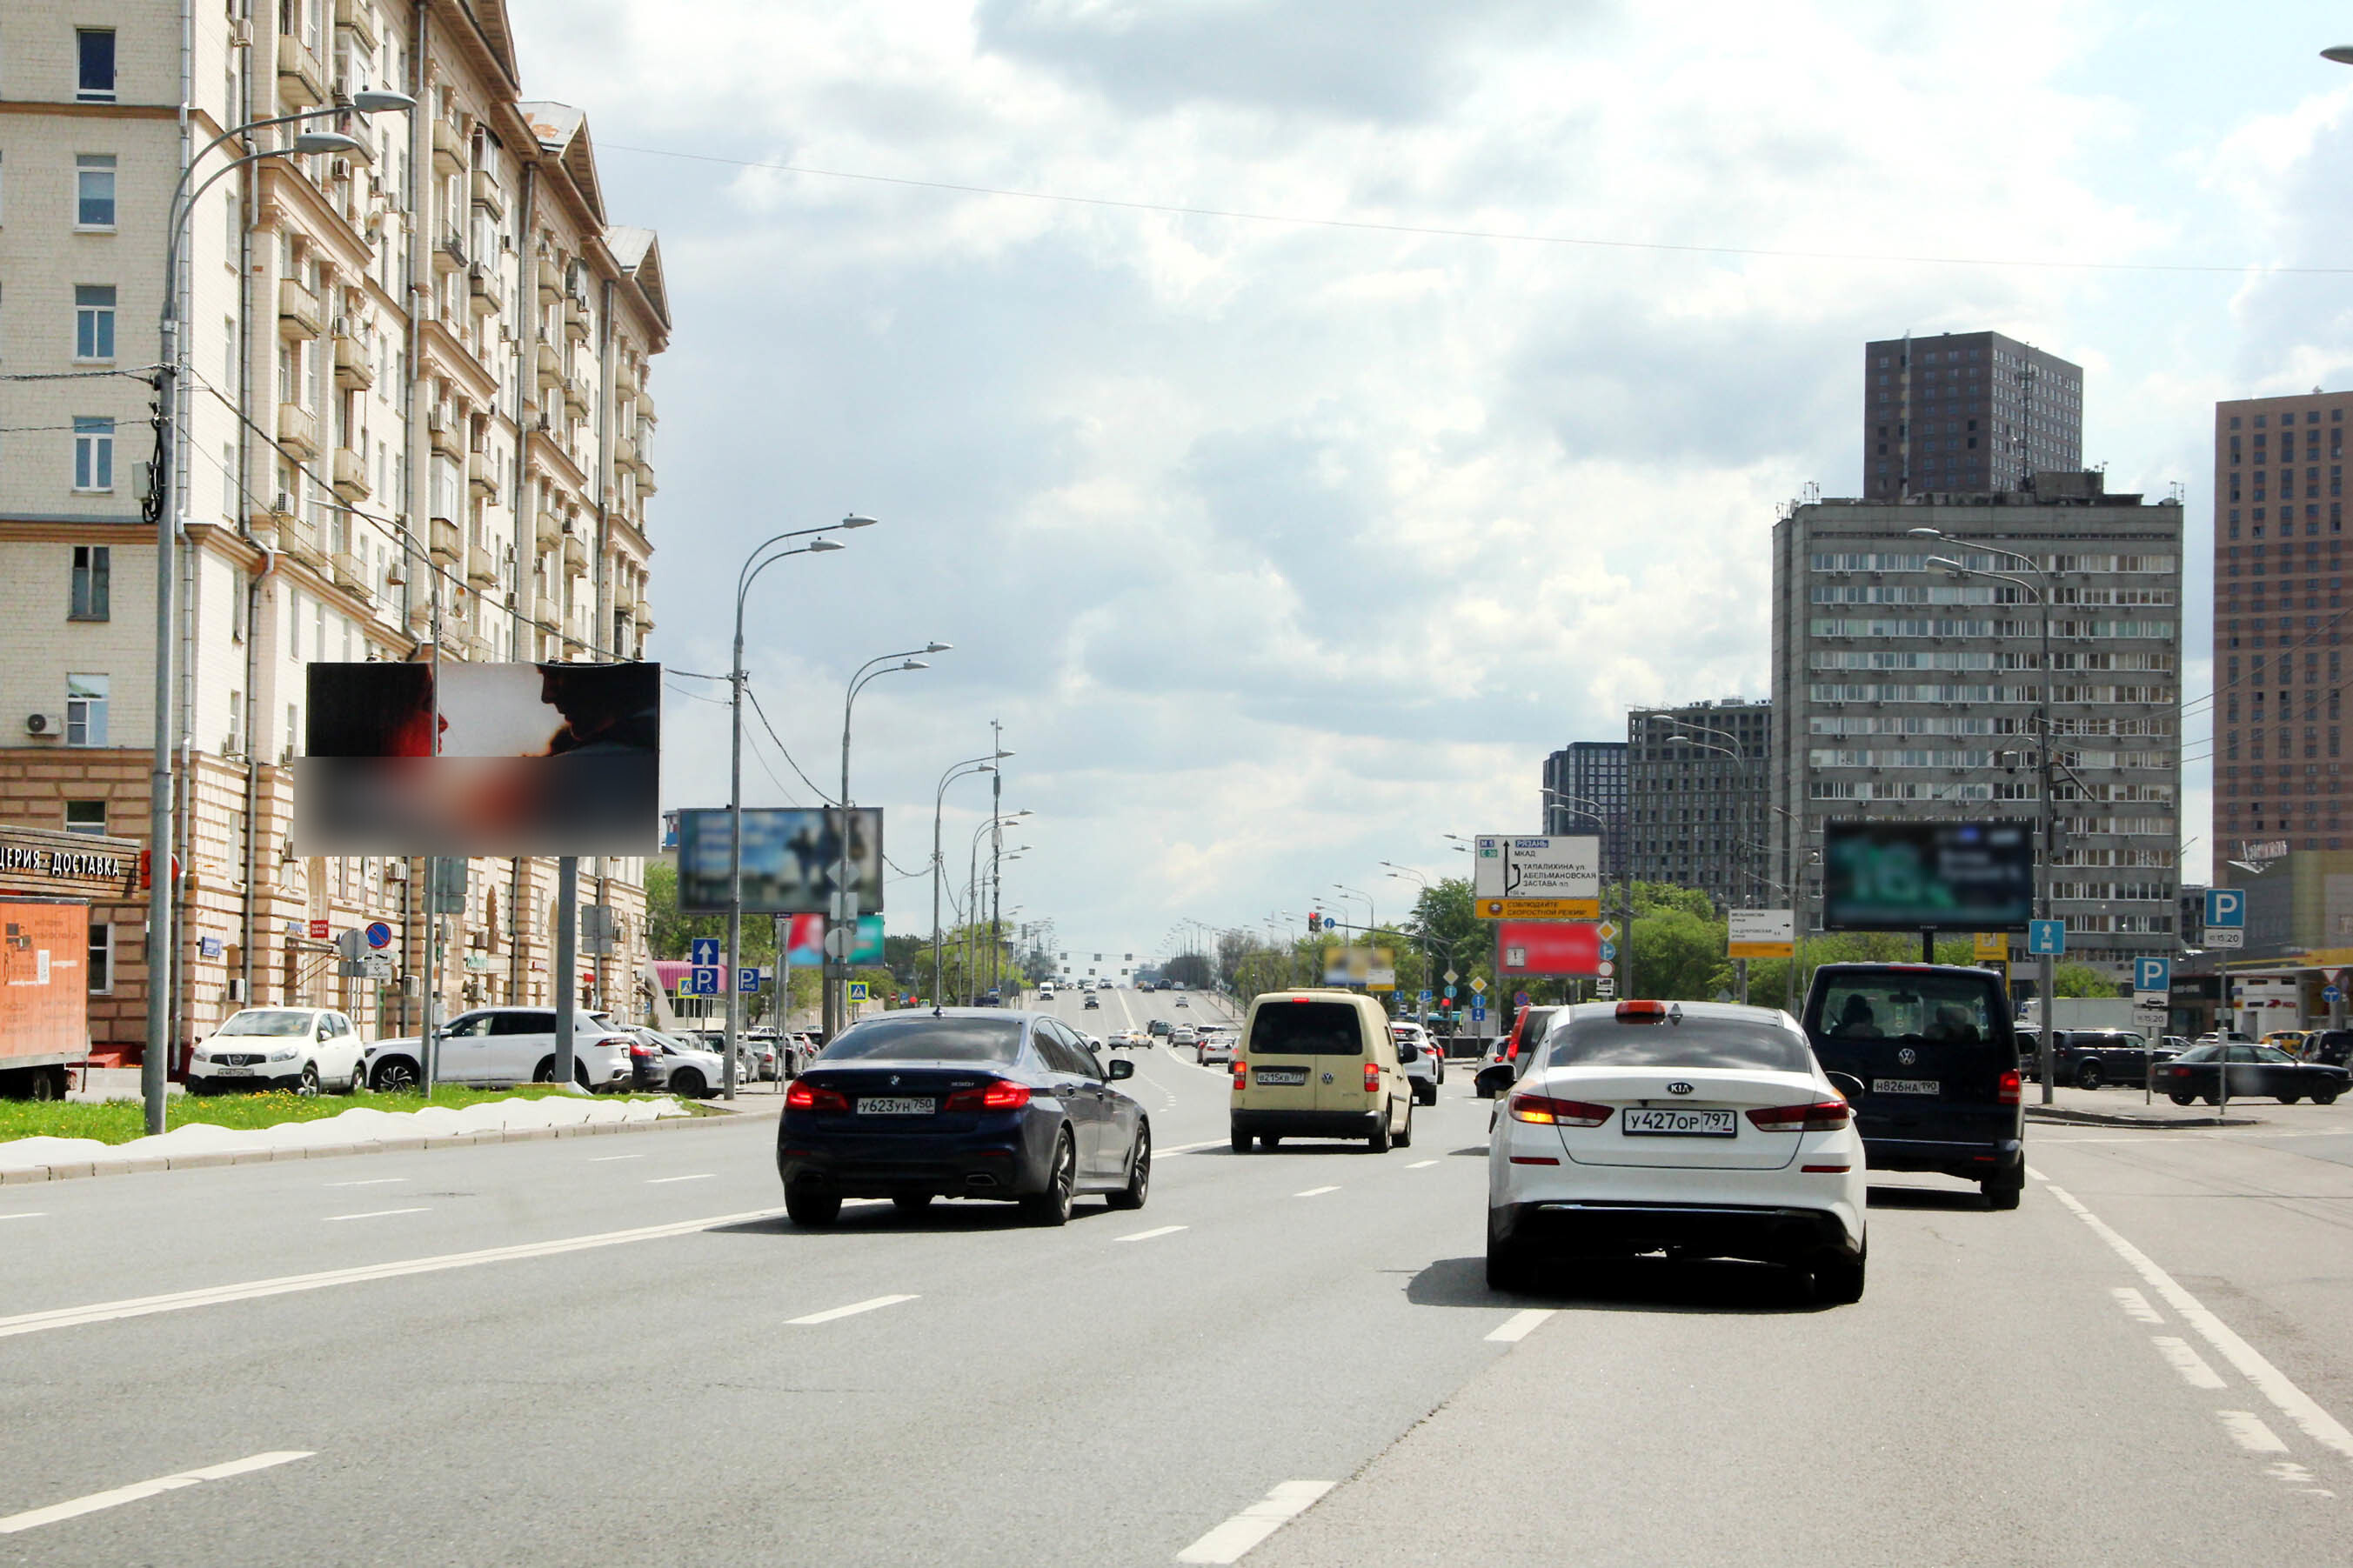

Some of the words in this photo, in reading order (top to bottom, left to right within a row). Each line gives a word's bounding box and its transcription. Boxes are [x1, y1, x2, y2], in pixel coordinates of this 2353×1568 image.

[52, 852, 120, 877] ДОСТАВКА
[2216, 894, 2237, 923] P
[2226, 934, 2239, 943] 20
[2143, 961, 2162, 987] P
[1876, 1081, 1918, 1092] Н826НА
[861, 1099, 911, 1112] У623УН
[913, 1098, 932, 1108] 750
[1631, 1112, 1699, 1130] У427ОР
[1703, 1113, 1729, 1126] 797
